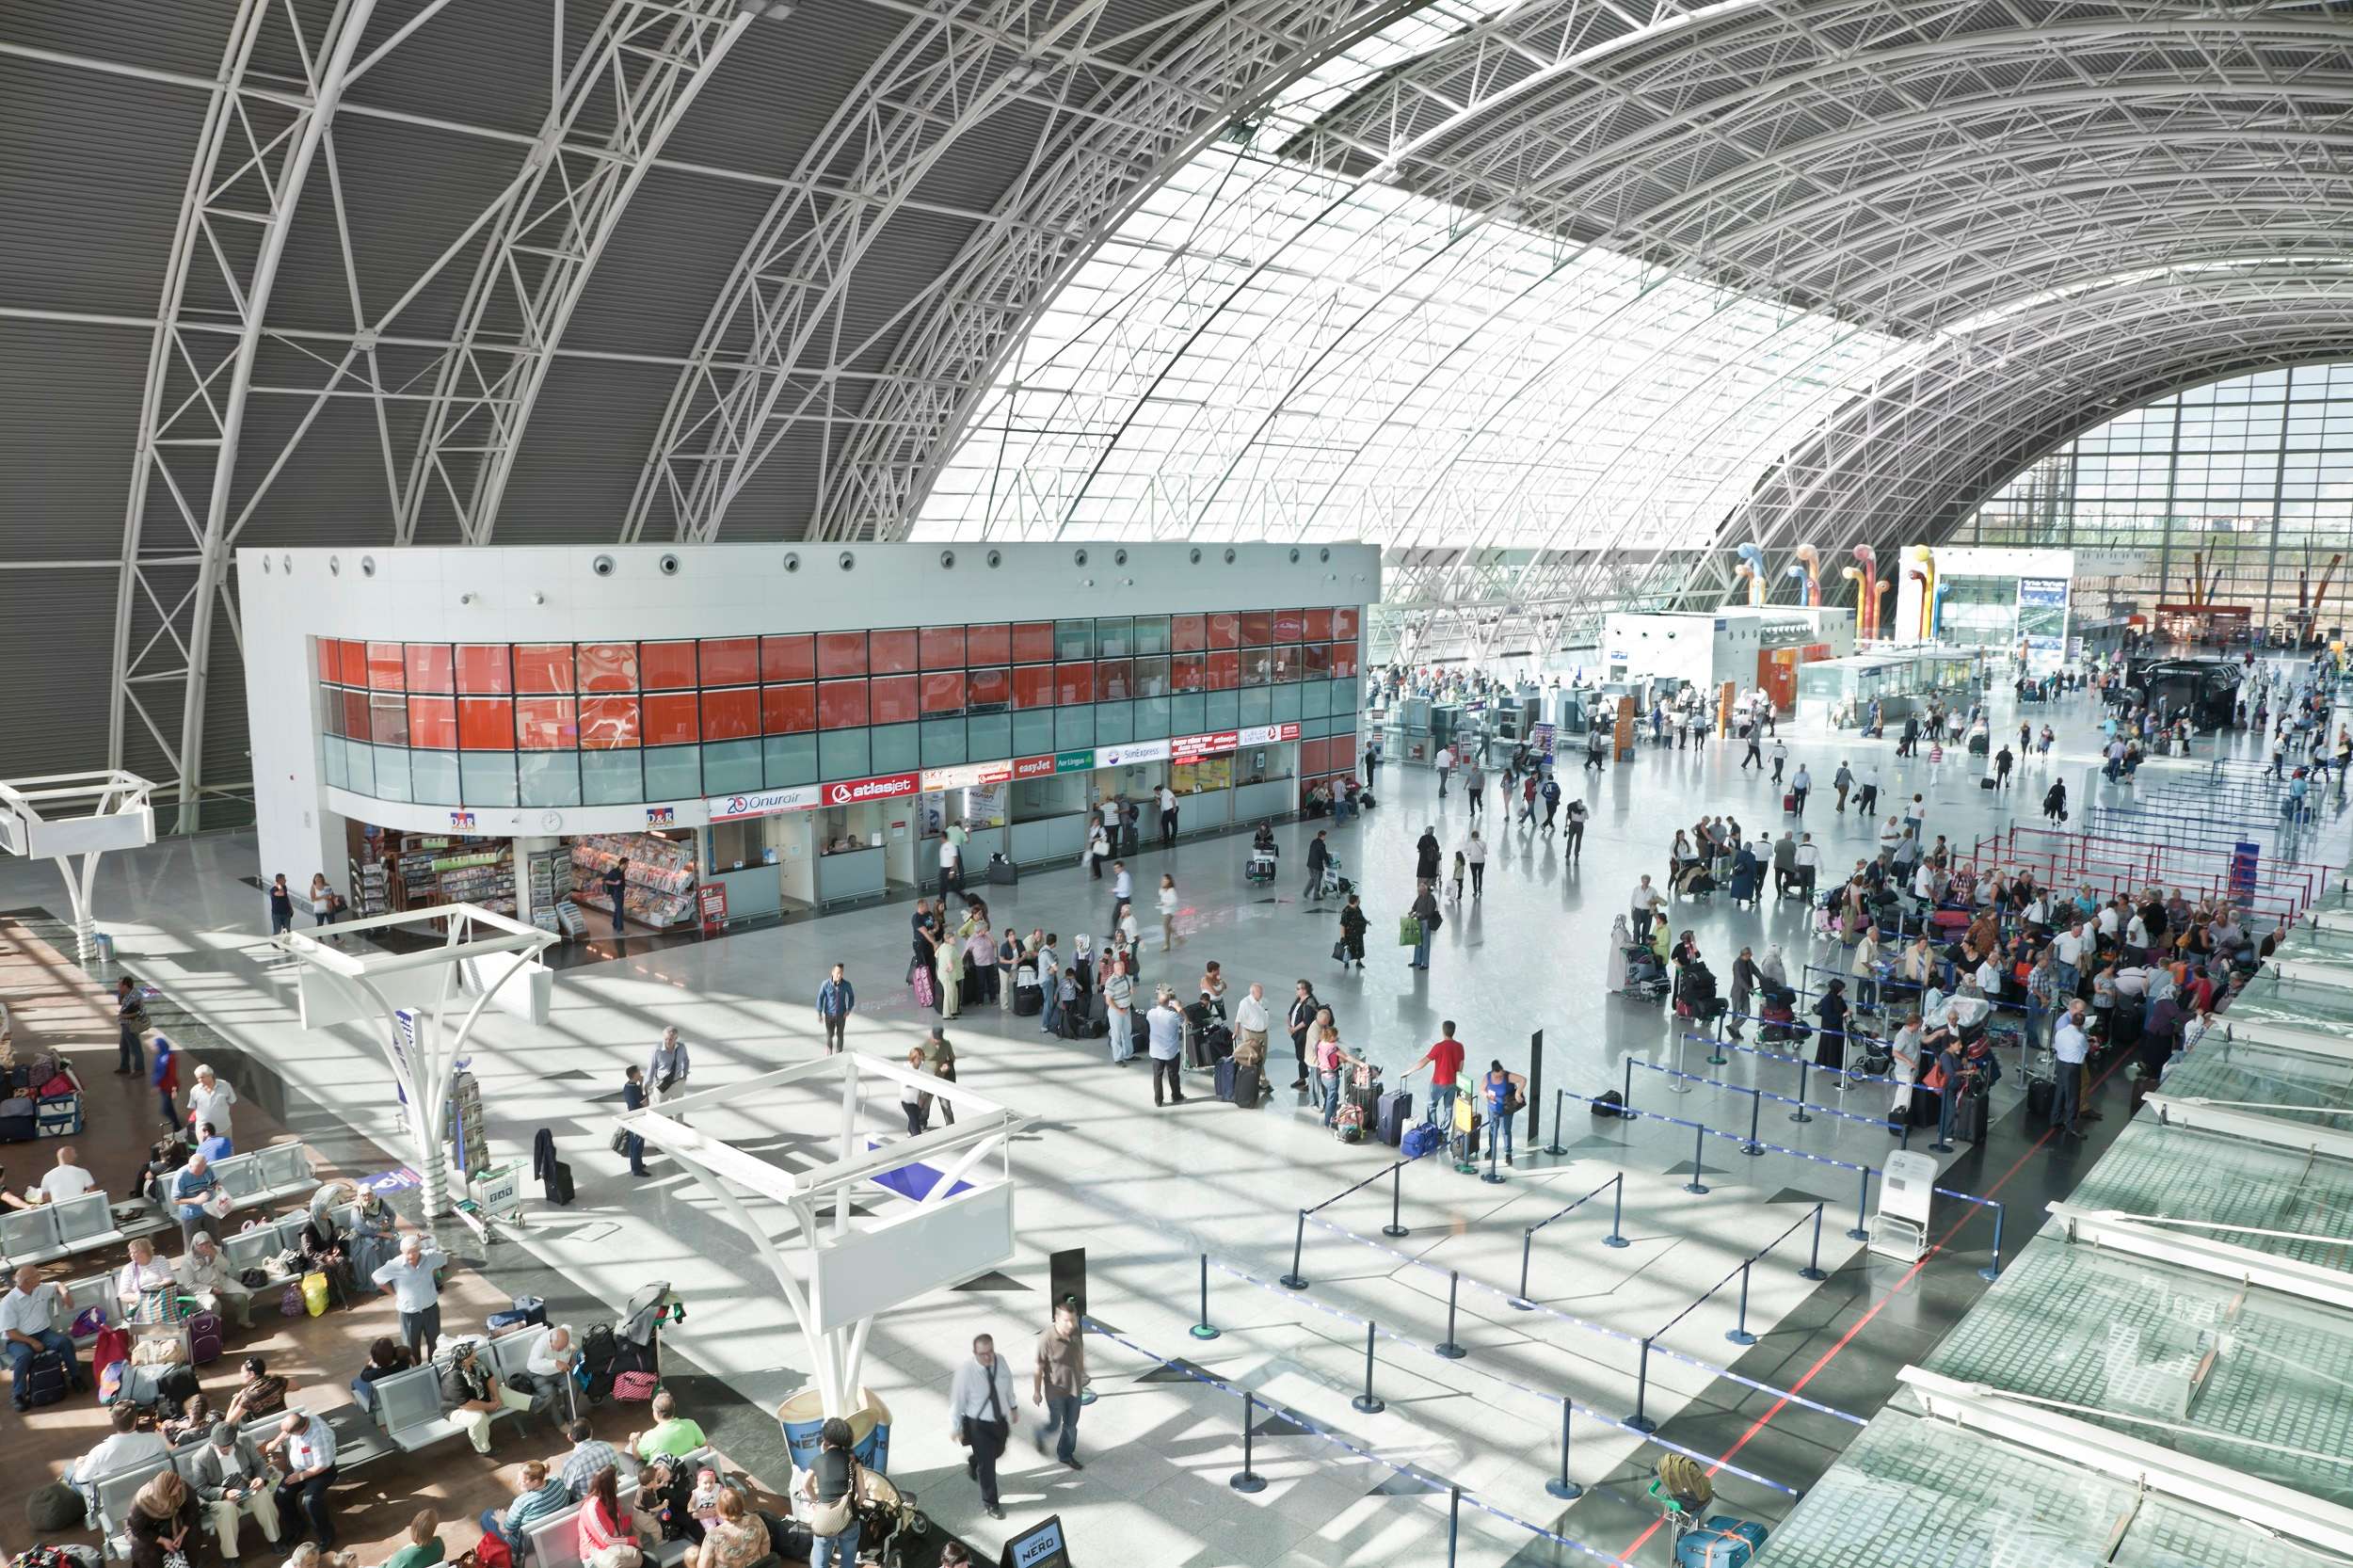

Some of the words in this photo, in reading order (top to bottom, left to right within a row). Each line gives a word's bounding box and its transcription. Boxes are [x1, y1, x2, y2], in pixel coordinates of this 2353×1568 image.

[1125, 746, 1160, 760] SunExpress
[1018, 760, 1051, 774] easyJet
[1057, 759, 1067, 767] Aer
[1068, 757, 1084, 766] Lingus
[853, 778, 911, 798] atlasjet
[451, 817, 474, 829] D&R
[647, 812, 673, 824] D&R
[1022, 1538, 1054, 1562] NERO
